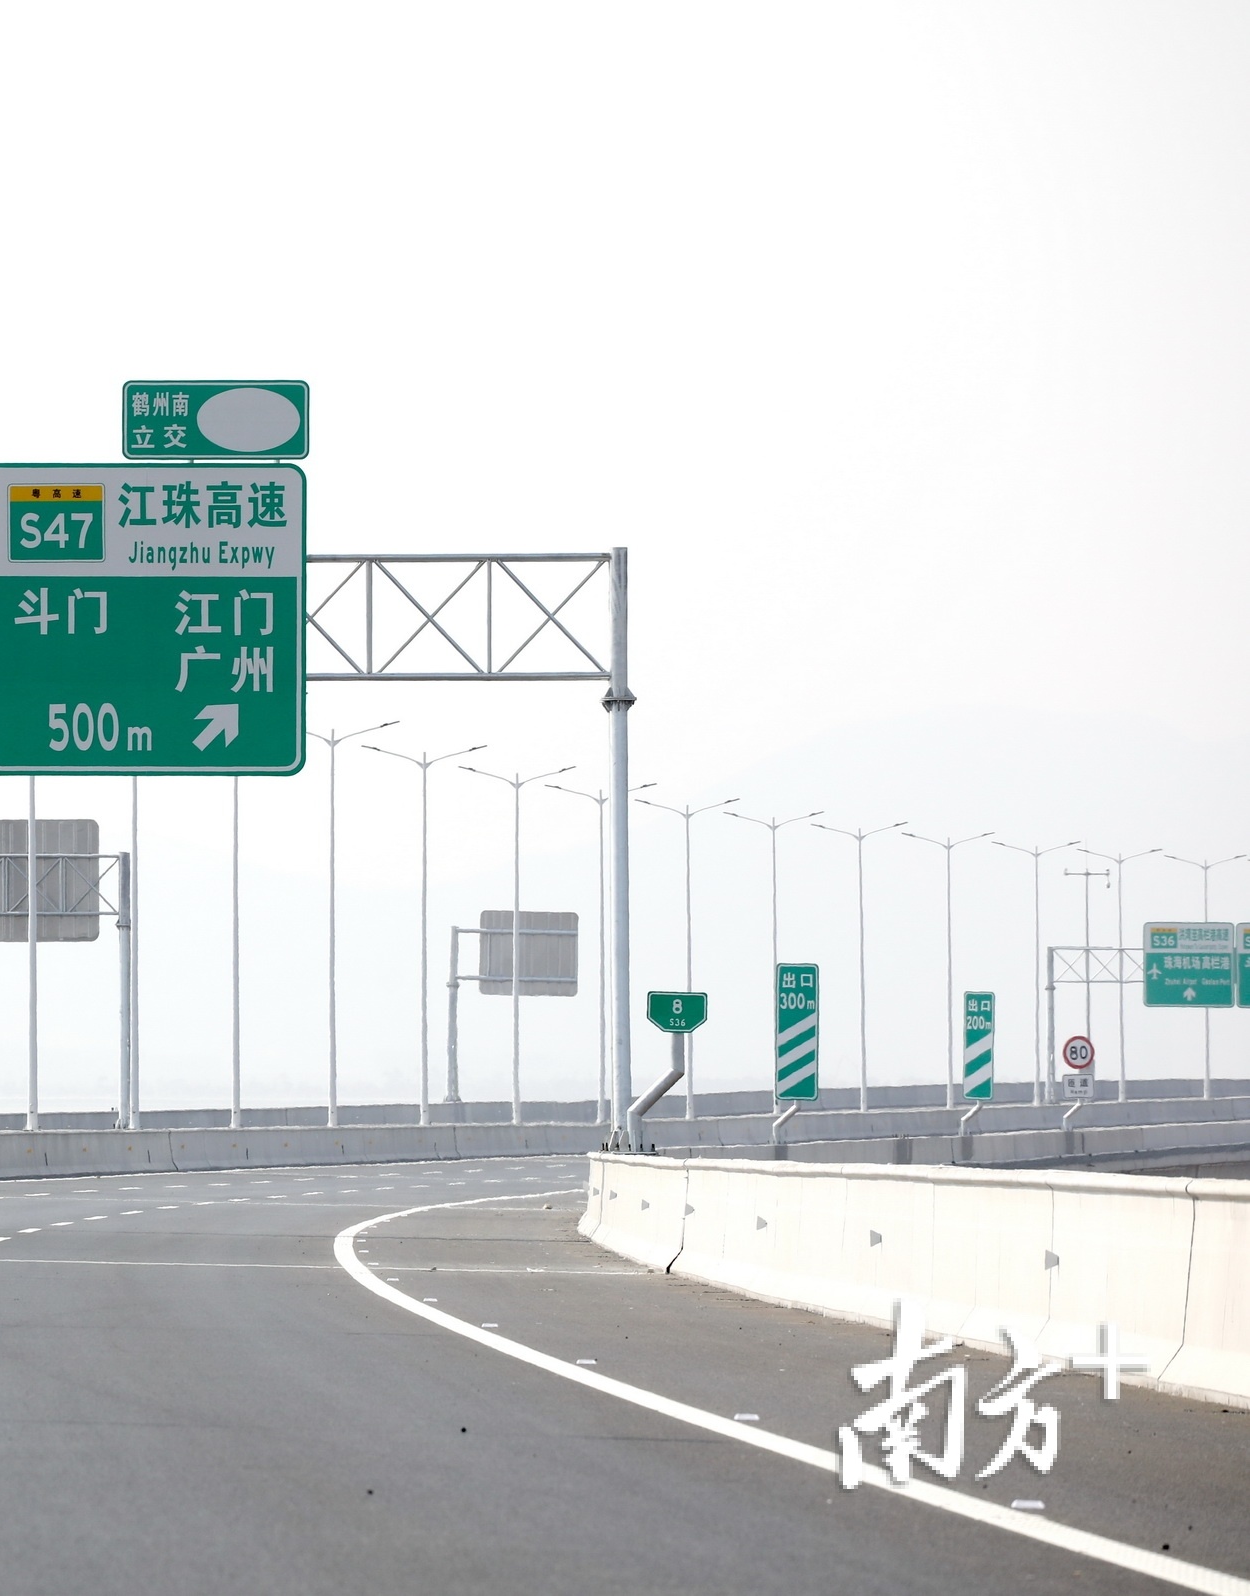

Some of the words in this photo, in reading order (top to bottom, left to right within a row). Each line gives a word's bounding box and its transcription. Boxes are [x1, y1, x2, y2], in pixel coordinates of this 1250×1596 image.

[132, 392, 189, 417] 鹤州南
[131, 424, 187, 448] 立交
[32, 489, 82, 499] 粤高速
[118, 481, 288, 529] 江珠高速
[20, 512, 93, 549] S47
[129, 541, 211, 571] Jiangzhu
[218, 541, 275, 569] Expwy
[14, 587, 108, 635] 斗门
[174, 588, 274, 636] 江门
[175, 645, 274, 693] 广州
[1153, 935, 1175, 947] S36
[782, 972, 813, 988] 出口
[672, 999, 683, 1014] 8
[968, 999, 990, 1012] 出口
[669, 1018, 686, 1027] S36
[1070, 1045, 1088, 1060] 80
